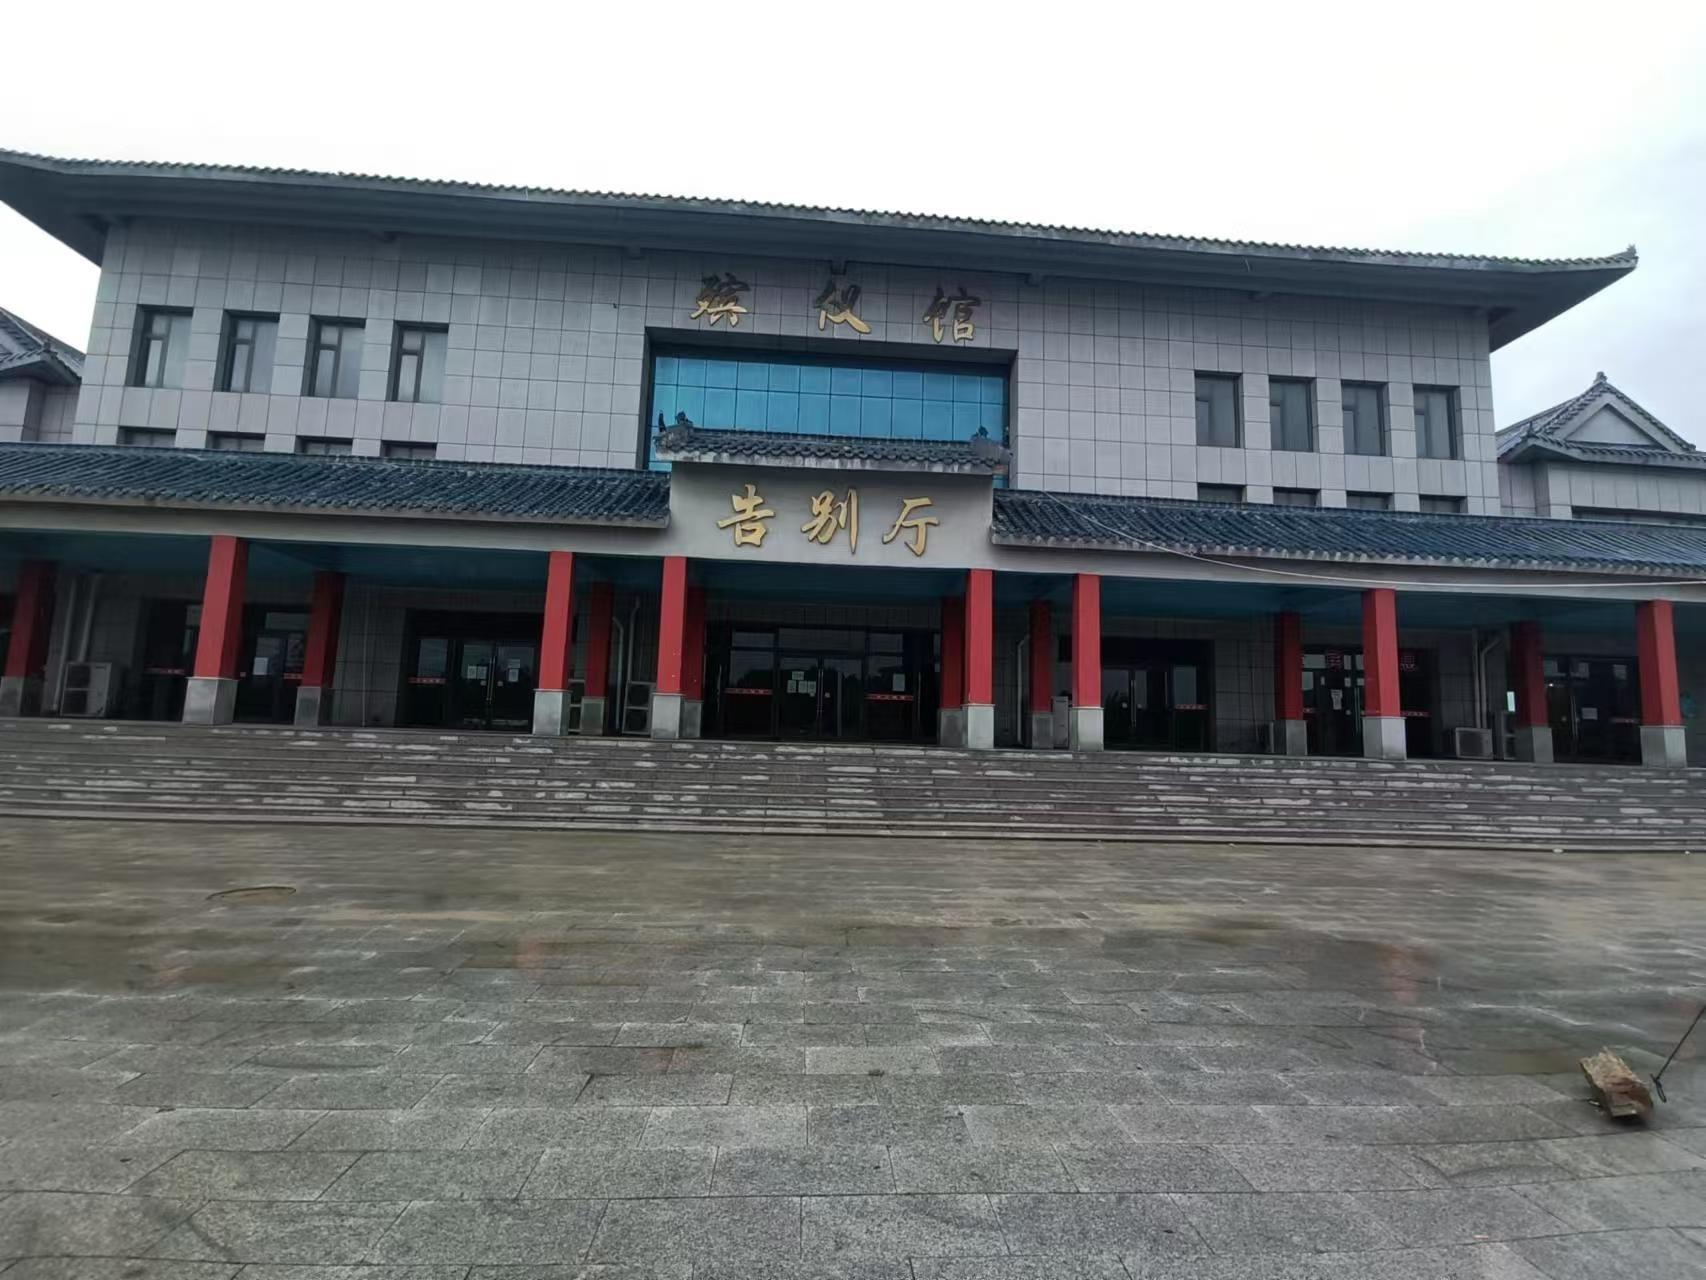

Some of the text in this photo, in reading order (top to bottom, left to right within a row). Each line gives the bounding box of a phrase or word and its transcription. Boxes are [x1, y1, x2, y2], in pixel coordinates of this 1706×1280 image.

[690, 273, 981, 343] 殡仪馆
[716, 484, 940, 556] 告别厅
